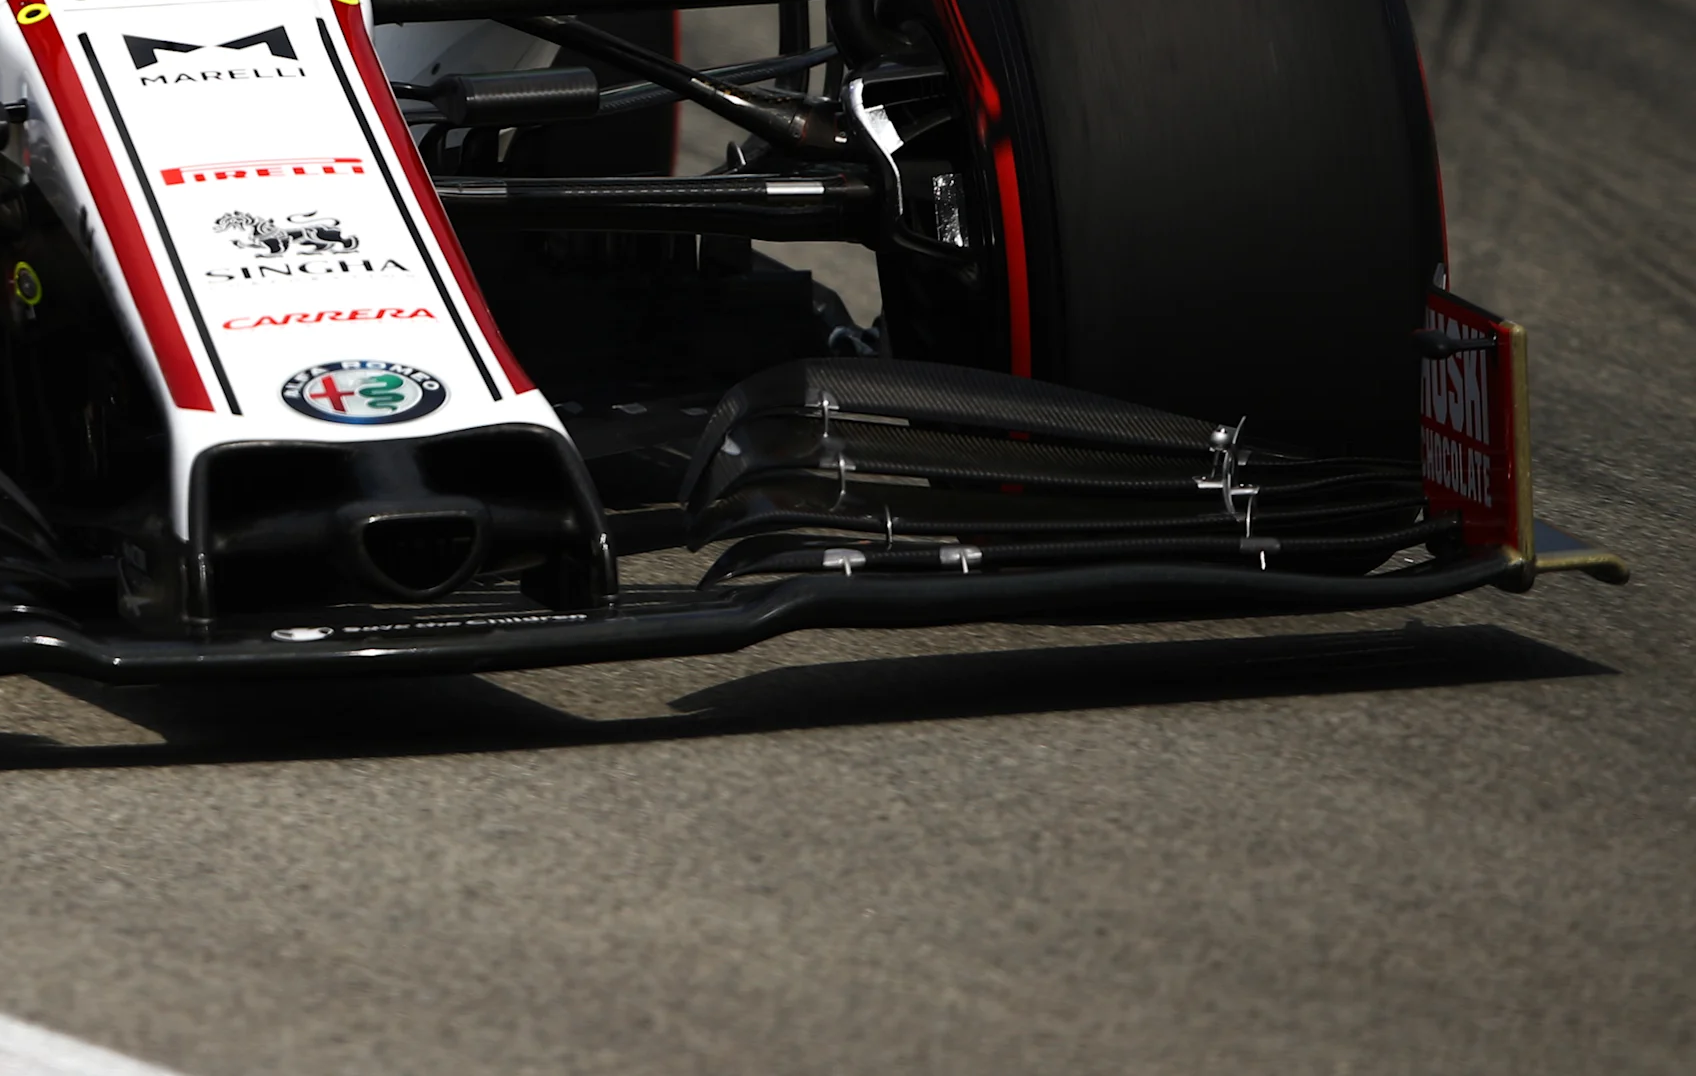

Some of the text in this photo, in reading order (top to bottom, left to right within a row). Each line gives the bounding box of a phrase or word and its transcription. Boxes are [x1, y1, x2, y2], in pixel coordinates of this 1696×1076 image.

[140, 67, 306, 87] MARELLI
[160, 158, 365, 186] PIRELLI
[205, 258, 410, 283] SINGHA
[222, 307, 436, 330] CARRERA
[283, 360, 440, 399] ALFA ROMEO
[1420, 425, 1493, 508] CHOCOLATE
